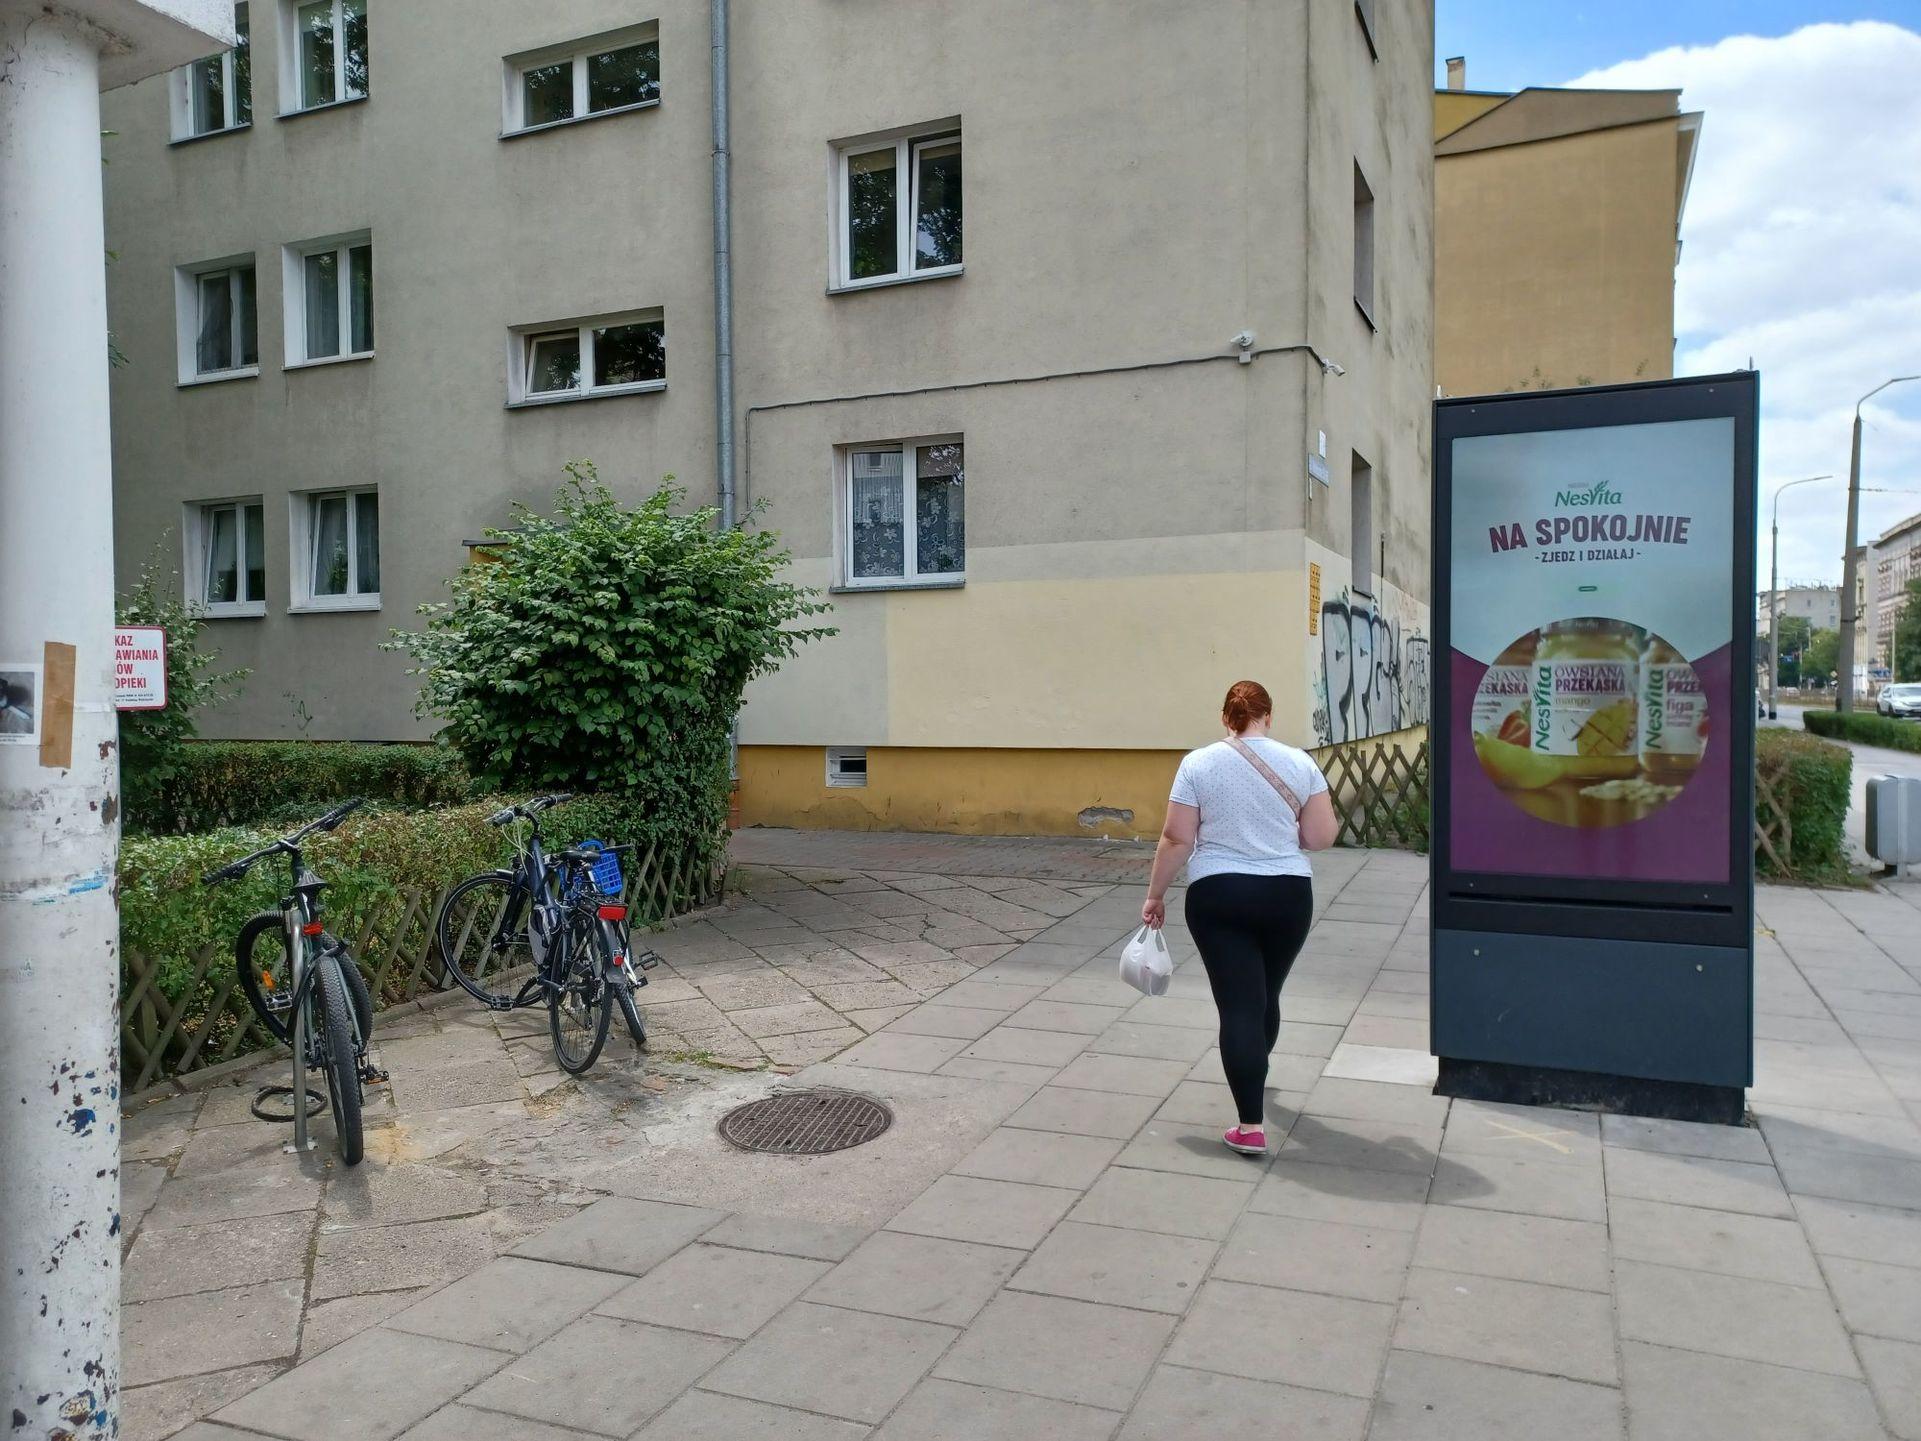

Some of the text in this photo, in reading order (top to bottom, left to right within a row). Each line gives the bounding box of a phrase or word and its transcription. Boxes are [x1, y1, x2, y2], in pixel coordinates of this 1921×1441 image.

[1554, 484, 1623, 507] NesVita
[1489, 514, 1691, 553] NA SPOKOJNIE
[116, 649, 159, 661] AWIANIA
[117, 661, 133, 674] ÓW
[1555, 665, 1625, 678] OWSIANA
[1555, 678, 1625, 694] PRZEKĄSKA
[1533, 665, 1552, 751] NesVita
[1645, 669, 1664, 749] NesVita
